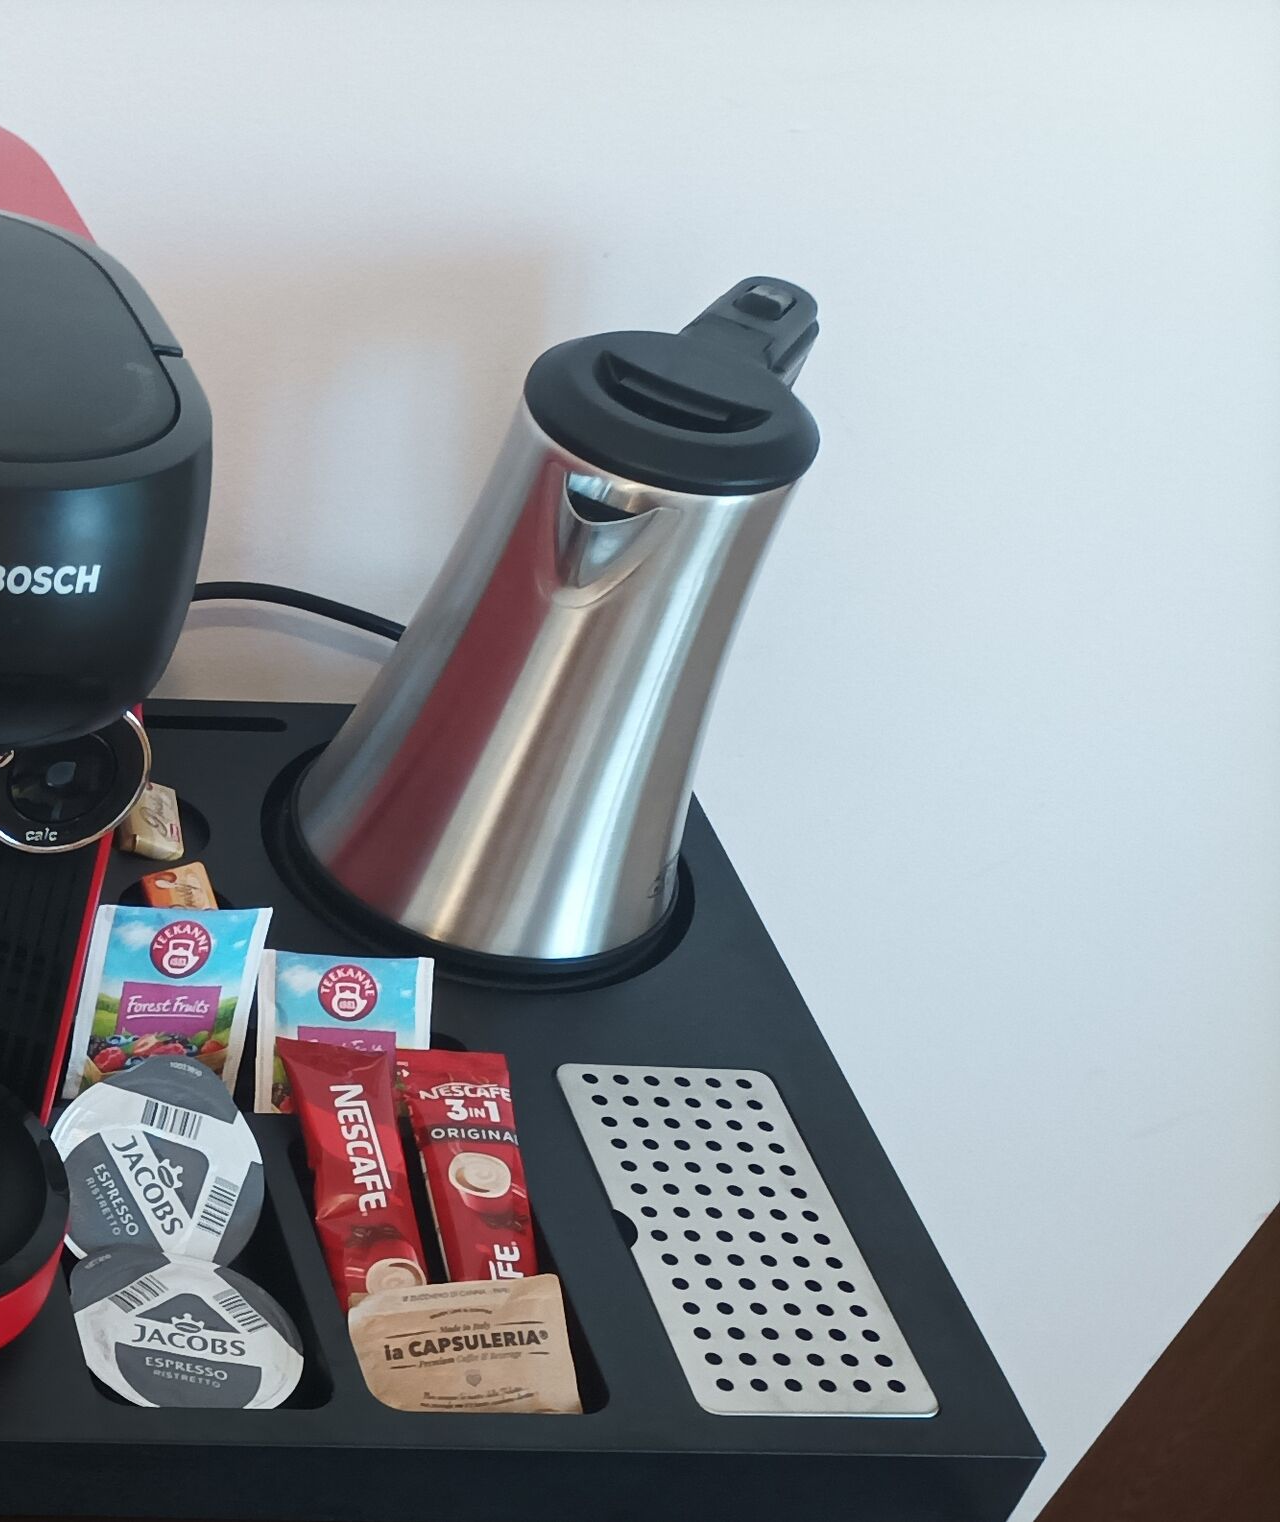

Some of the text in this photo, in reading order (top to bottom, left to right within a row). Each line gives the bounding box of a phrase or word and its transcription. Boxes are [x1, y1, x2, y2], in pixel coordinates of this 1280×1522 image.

[25, 827, 58, 841] calc
[153, 924, 209, 953] TEEKANNE
[320, 968, 375, 997] TEEKANNE
[126, 994, 211, 1015] Forest Fruits
[92, 1163, 139, 1236] ESPRESSO
[112, 1135, 183, 1235] JACOBS
[85, 1177, 121, 1236] RISTRETTO
[132, 1323, 246, 1357] JACOBS
[144, 1356, 228, 1381] ESPRESSO
[153, 1369, 221, 1389] RISTRETTO
